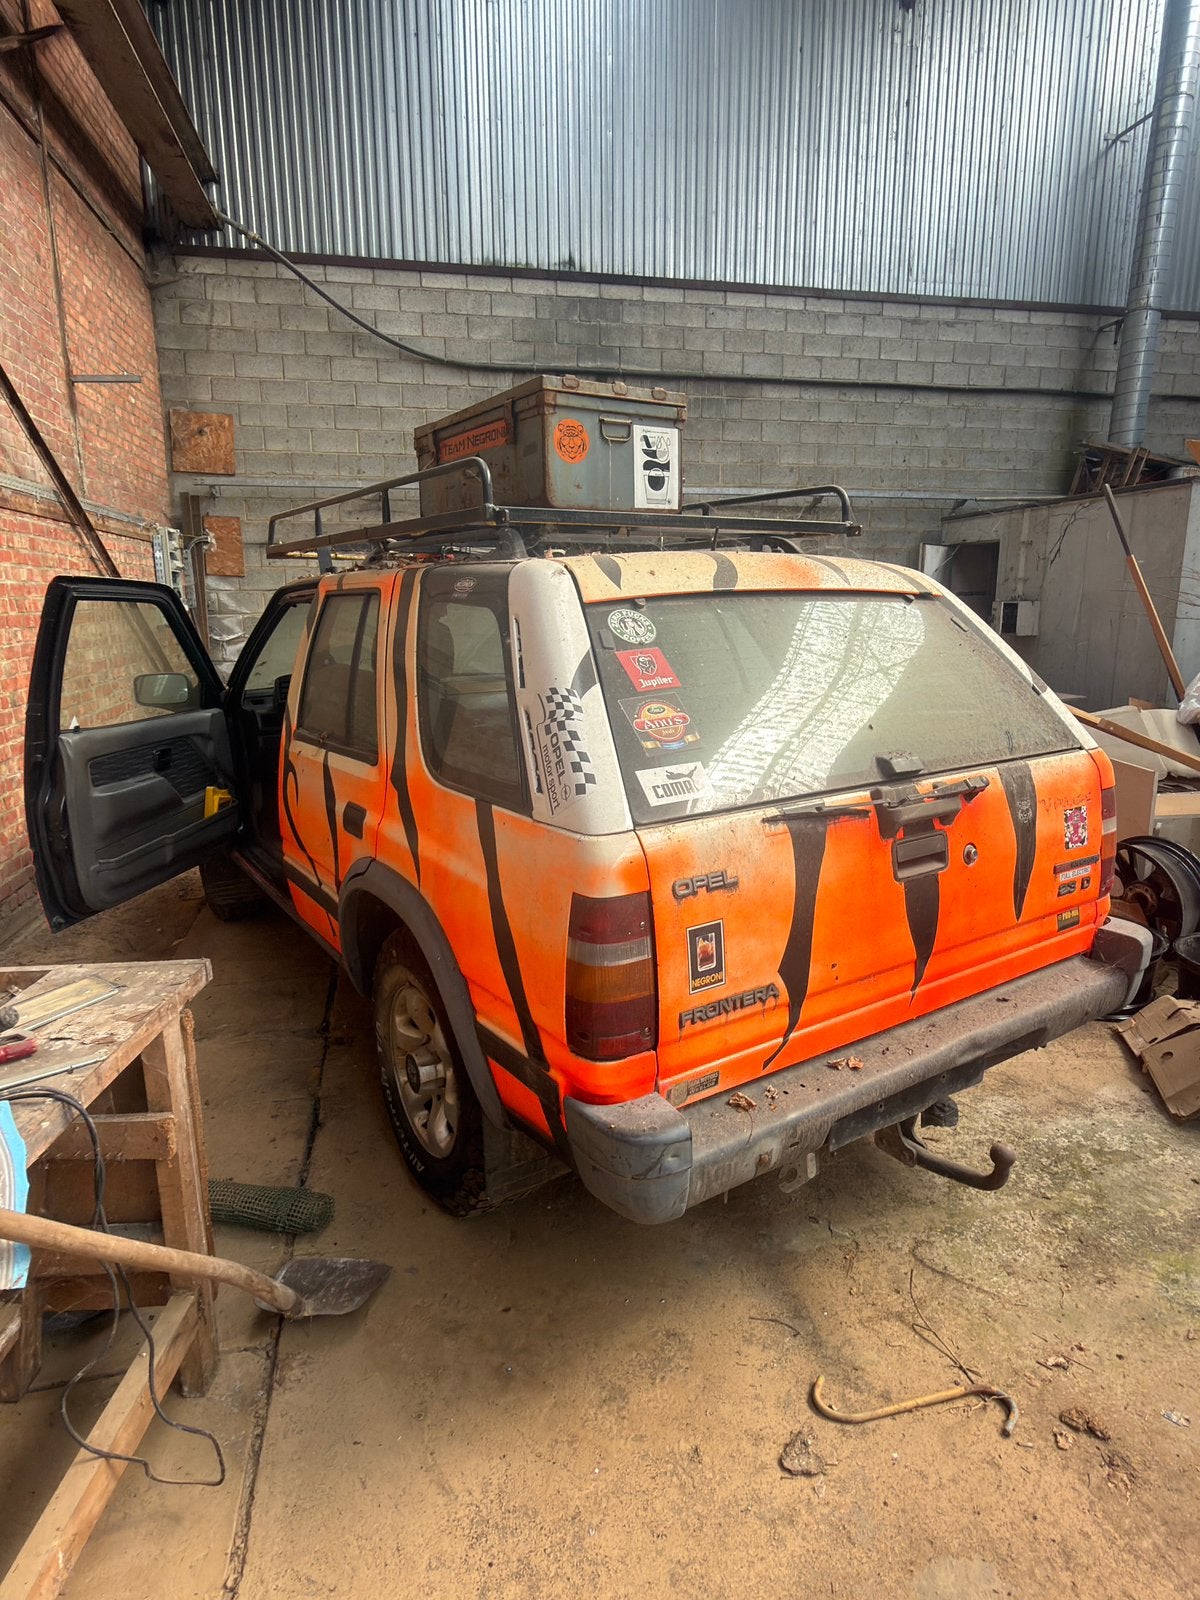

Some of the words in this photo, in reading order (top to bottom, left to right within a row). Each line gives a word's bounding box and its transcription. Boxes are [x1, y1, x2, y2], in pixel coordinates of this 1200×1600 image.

[638, 676, 674, 688] Jupiler
[550, 732, 566, 786] OPEL
[542, 744, 553, 779] motor
[548, 778, 561, 811] sport
[673, 870, 738, 898] OPEL
[691, 971, 724, 989] NEGRONI
[679, 983, 779, 1028] FRONTERA
